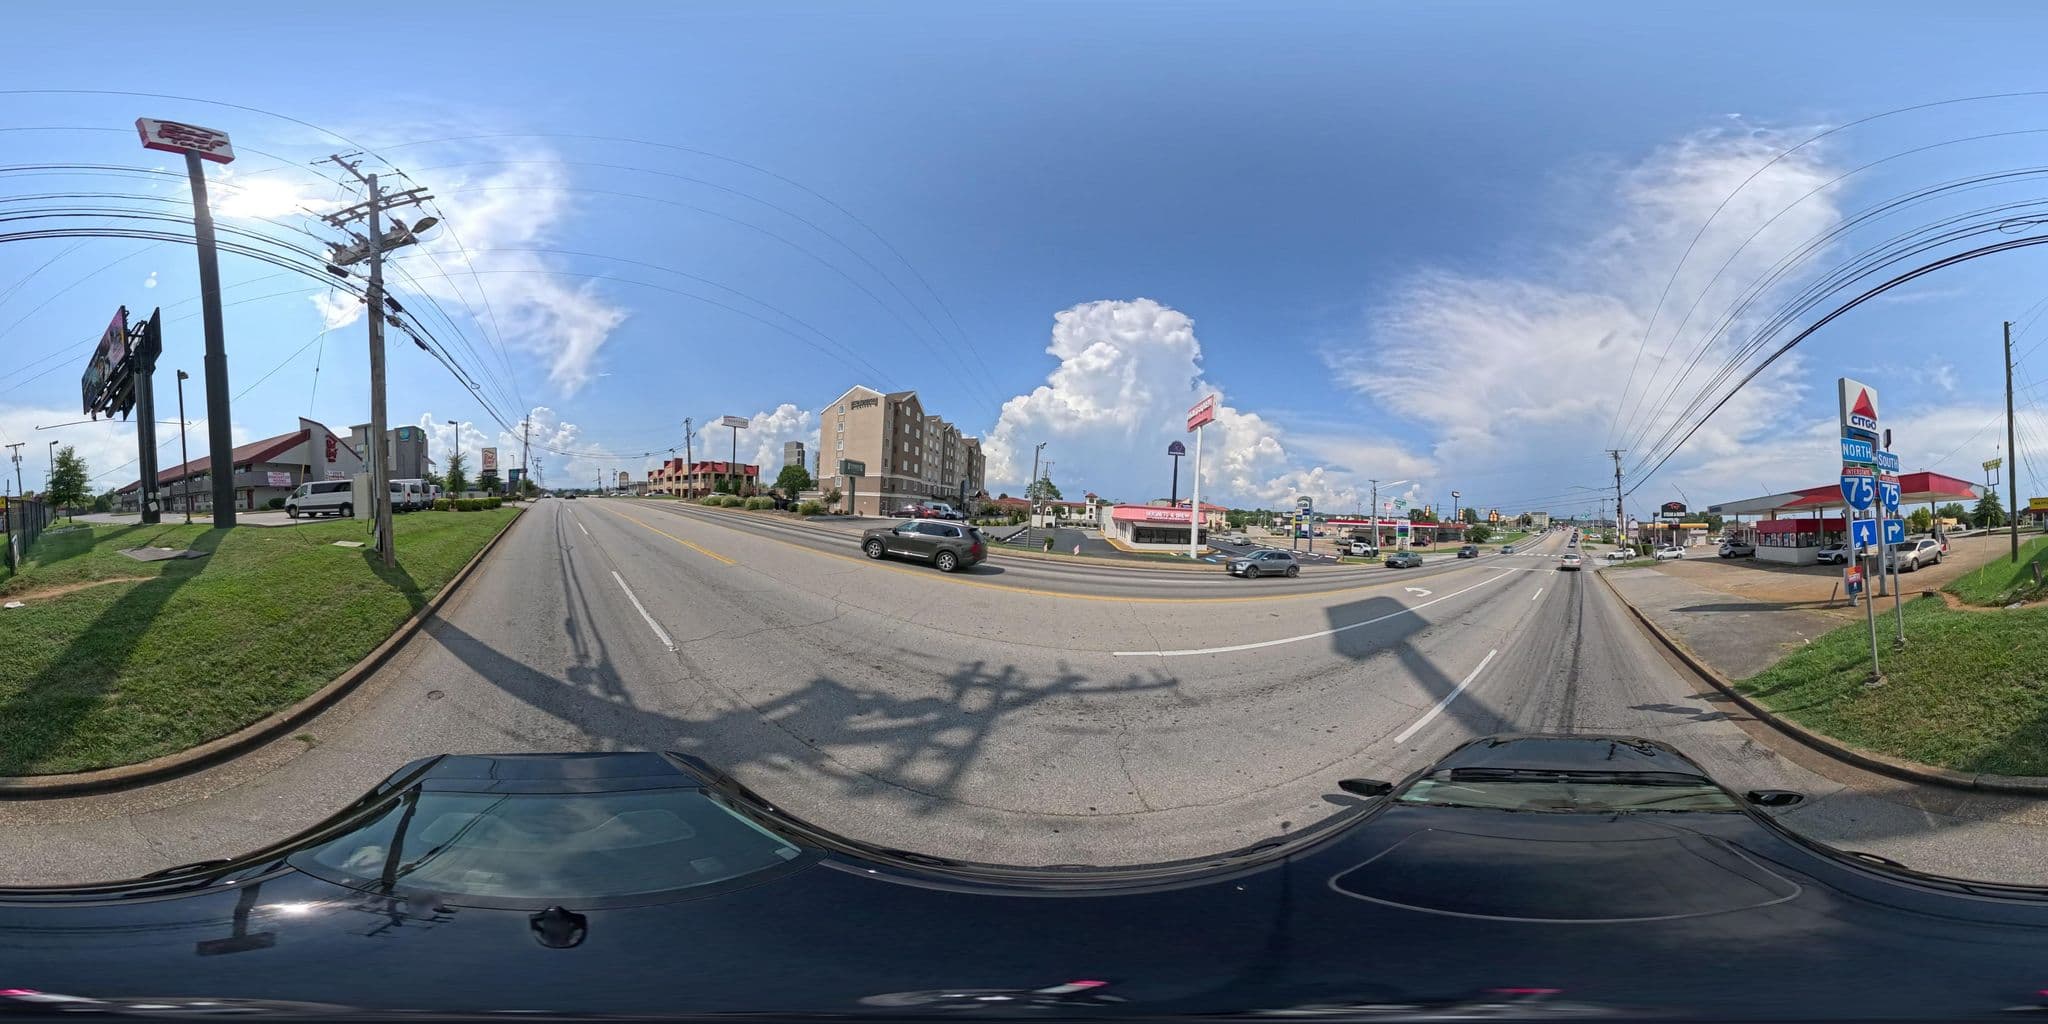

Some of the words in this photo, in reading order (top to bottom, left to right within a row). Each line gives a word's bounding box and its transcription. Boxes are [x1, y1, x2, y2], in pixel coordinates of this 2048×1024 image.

[1851, 415, 1877, 430] CITGO
[1842, 443, 1872, 459] NORTH
[1878, 454, 1898, 468] SOUTH
[1844, 477, 1874, 502] 75
[1882, 483, 1899, 505] 75
